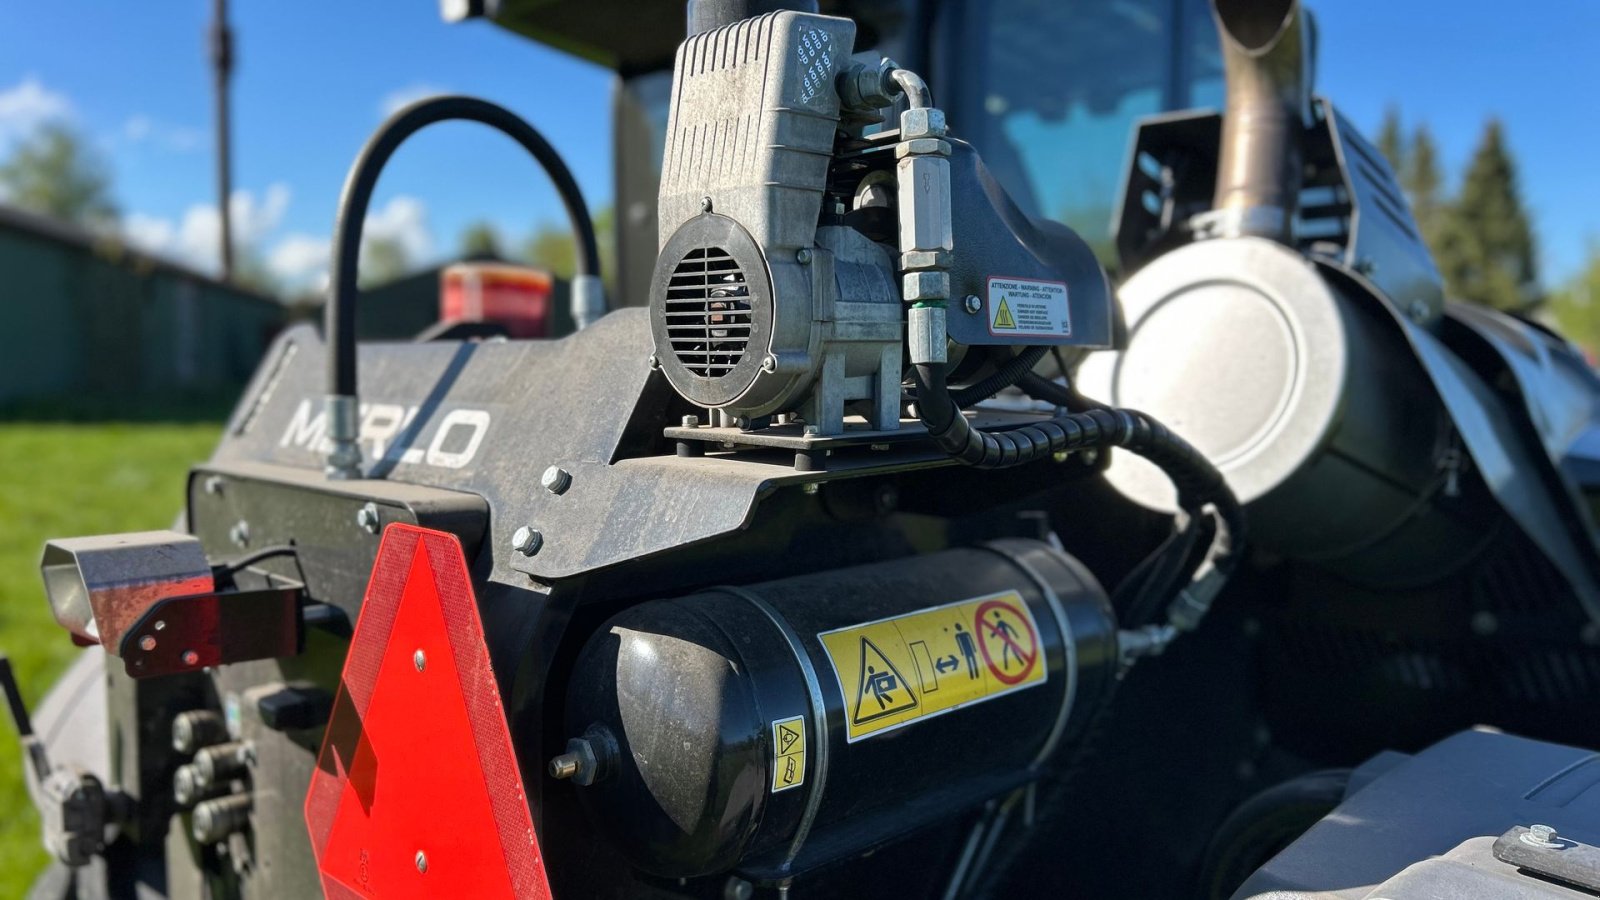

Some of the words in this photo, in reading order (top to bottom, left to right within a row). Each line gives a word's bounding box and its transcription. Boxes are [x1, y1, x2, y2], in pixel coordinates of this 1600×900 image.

[815, 59, 827, 80] VOID
[822, 51, 832, 72] VOI
[808, 66, 821, 88] VOID
[279, 399, 491, 469] MRLO
